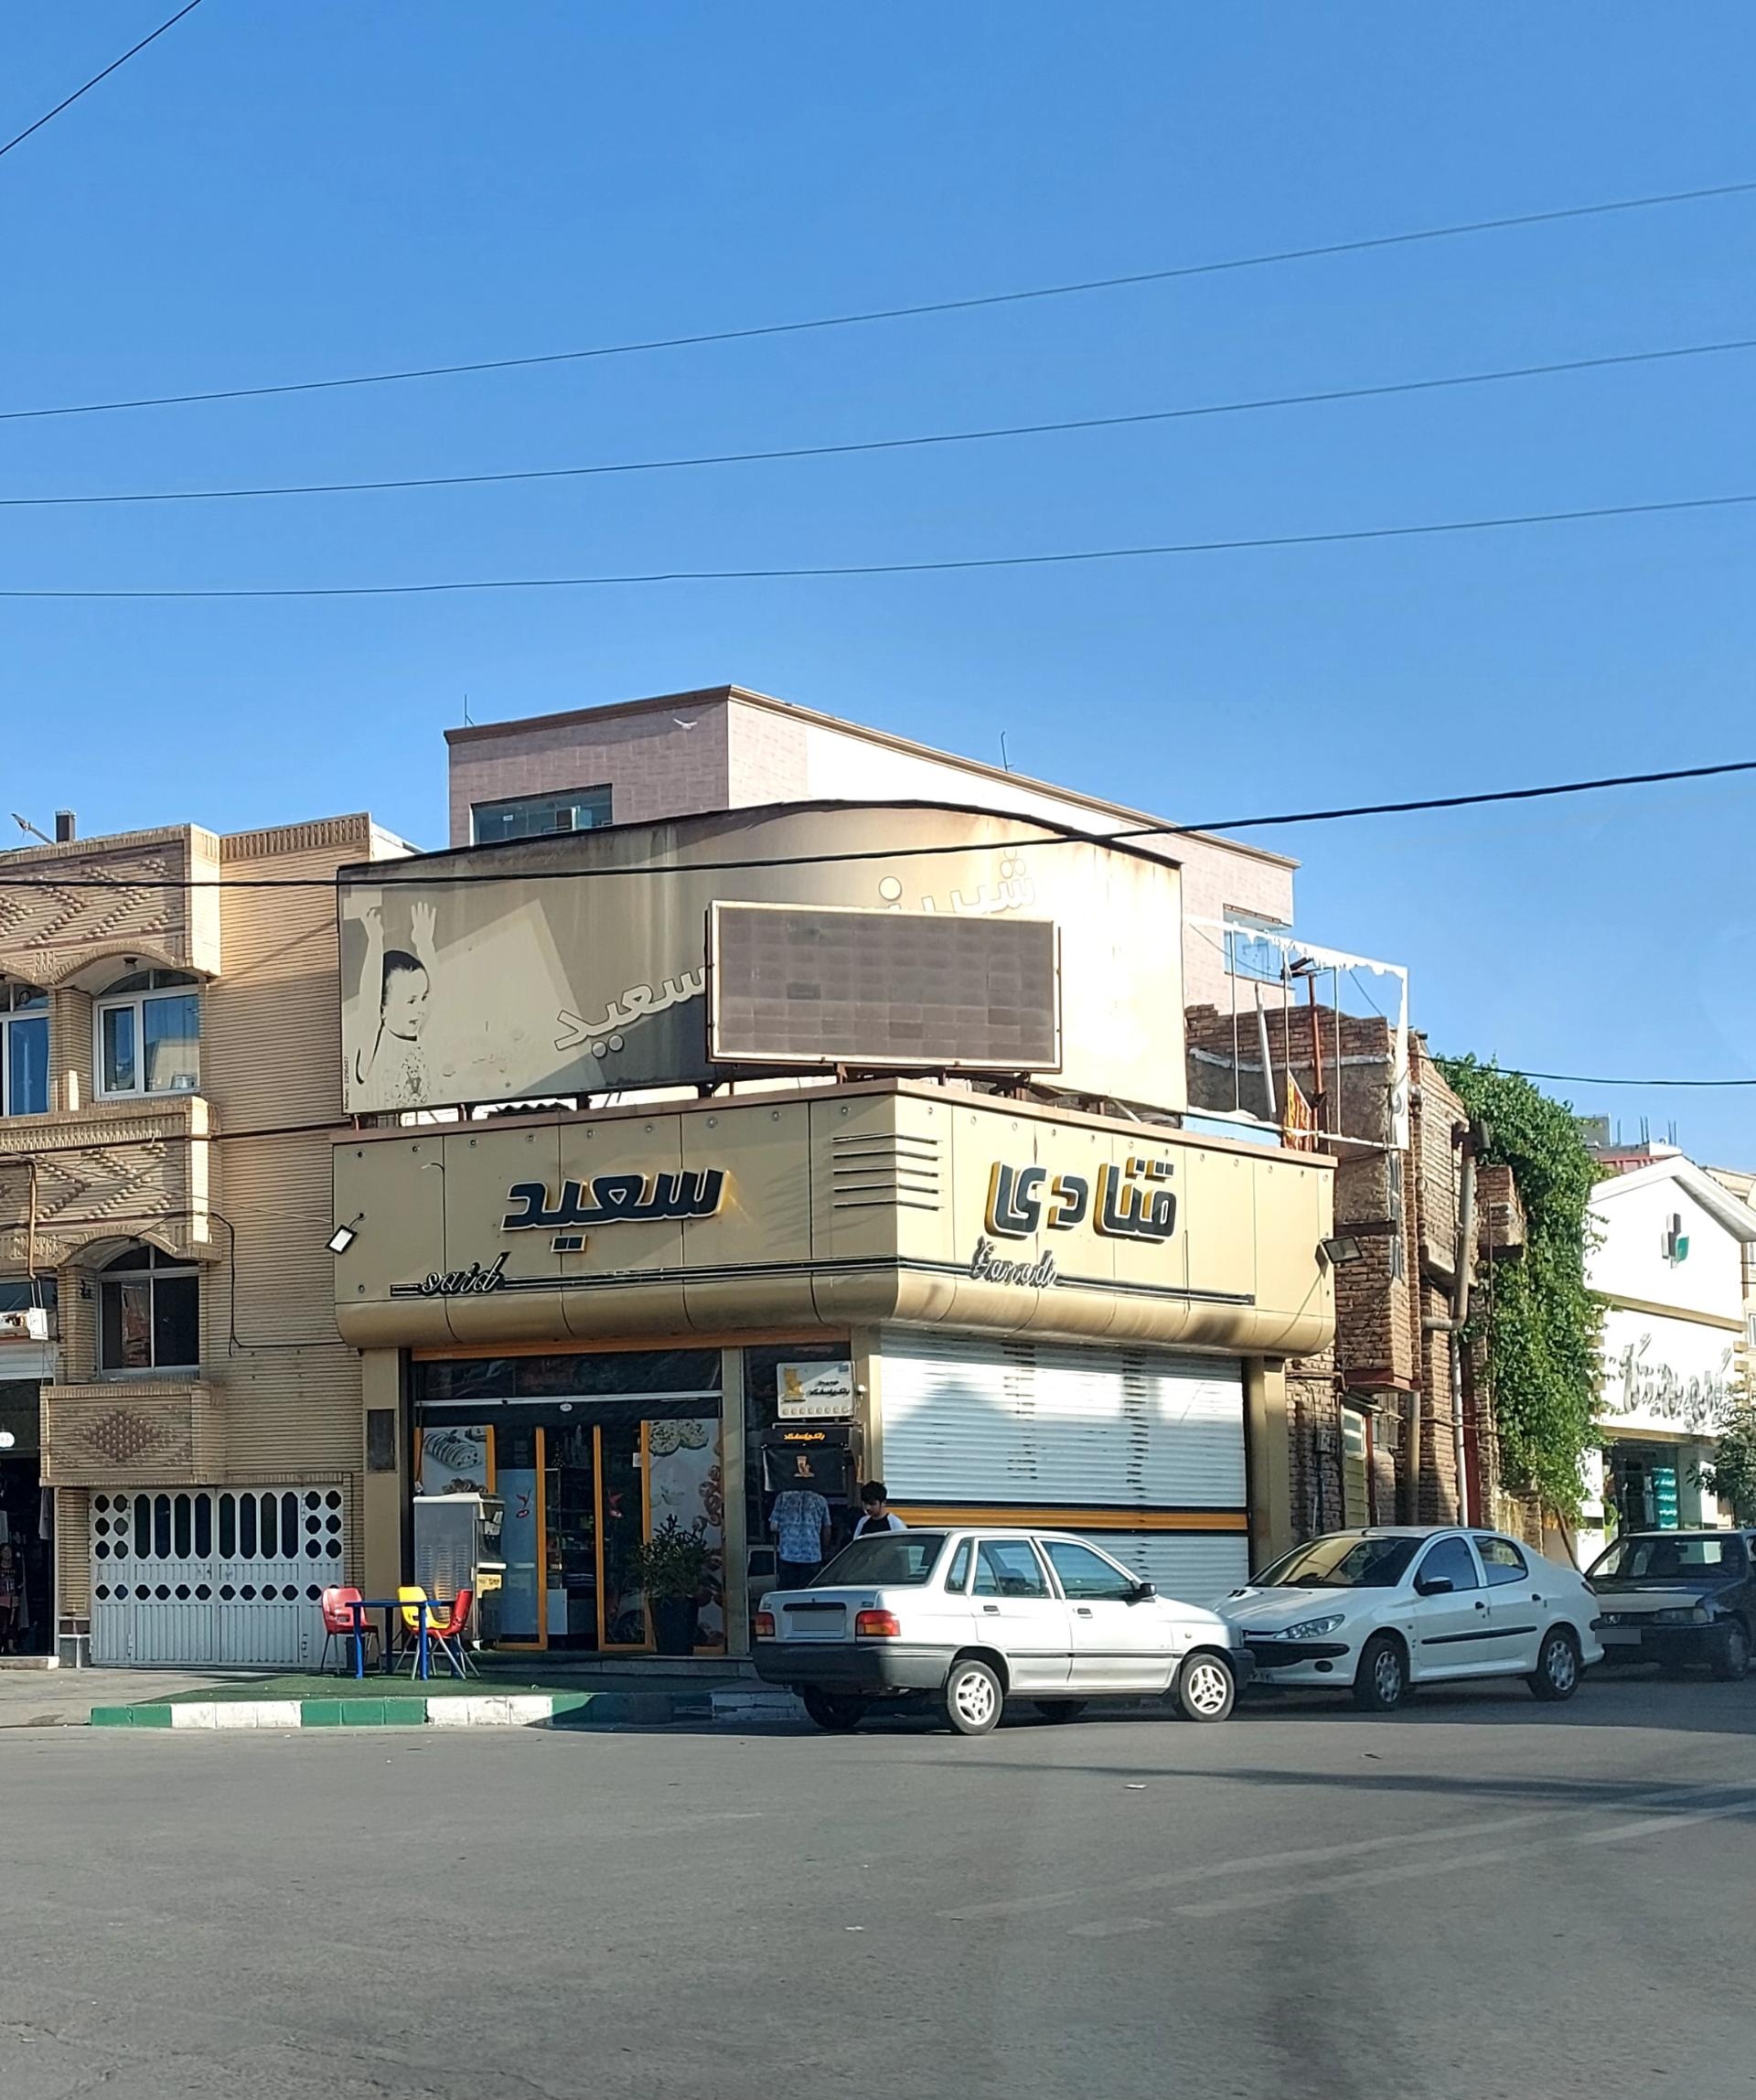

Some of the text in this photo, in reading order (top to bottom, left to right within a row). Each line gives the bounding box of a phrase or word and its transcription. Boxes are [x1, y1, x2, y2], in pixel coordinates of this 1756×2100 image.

[554, 965, 706, 1058] سعید
[500, 1168, 726, 1253] سعید
[984, 1156, 1177, 1245] قنادی
